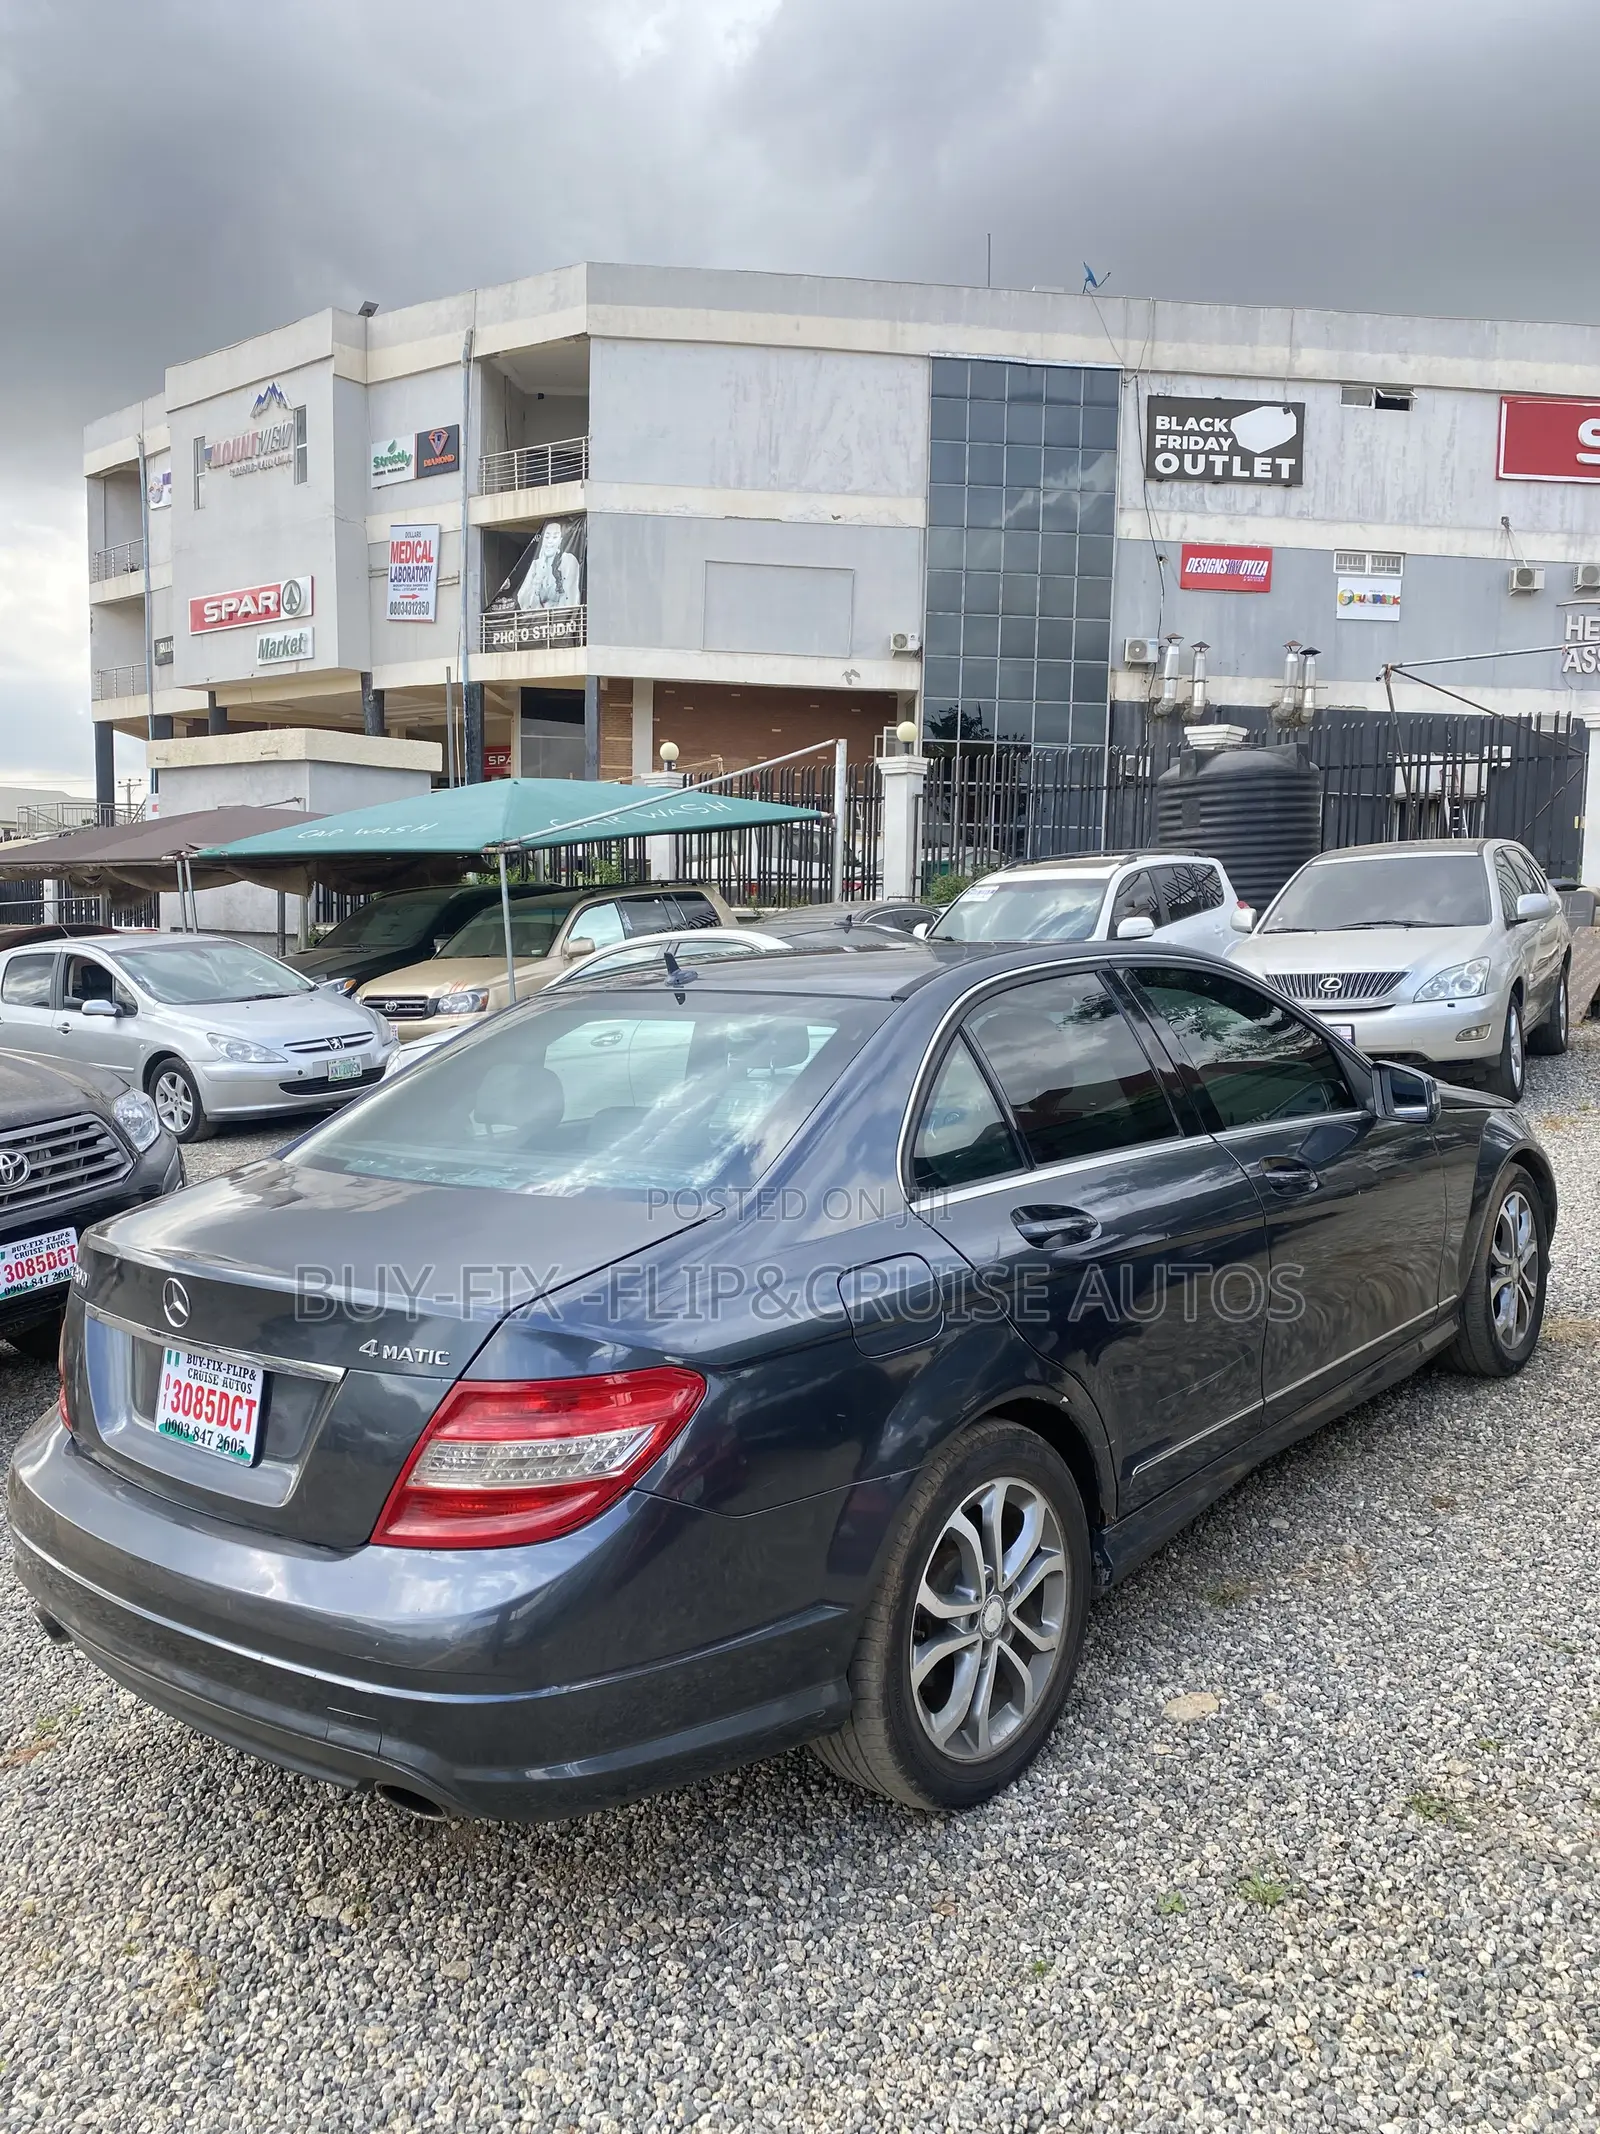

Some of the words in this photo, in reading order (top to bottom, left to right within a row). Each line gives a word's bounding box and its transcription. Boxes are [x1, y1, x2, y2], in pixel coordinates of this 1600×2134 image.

[1155, 415, 1229, 433] BLACK
[1155, 434, 1233, 452] FRIDAY
[373, 449, 413, 468] Strictly
[423, 454, 456, 467] DIAMOND
[1154, 452, 1296, 479] OUTLET
[390, 540, 434, 564] MEDICAL
[389, 565, 433, 583] LABORATORY
[203, 591, 279, 623] SPAR
[258, 632, 307, 660] Market
[632, 801, 732, 819] WASH
[354, 822, 439, 836] WASH
[11, 1231, 71, 1254] BUY-FIX-FLIP&
[14, 1246, 43, 1260] CRUISE
[46, 1238, 70, 1252] AUTOS
[4, 1244, 76, 1283] 3085DCT
[4, 1281, 29, 1295] 0903
[31, 1274, 49, 1287] 847
[359, 1339, 379, 1358] 4
[382, 1345, 450, 1366] MATIC
[186, 1353, 257, 1381] BUY-FIX-FLIP&
[187, 1368, 220, 1386] CRUISE
[222, 1376, 253, 1394] AUTOS
[170, 1379, 257, 1435] 3085DCT
[165, 1417, 190, 1439] 0903
[192, 1426, 214, 1446] 847
[216, 1433, 245, 1456] 2605
